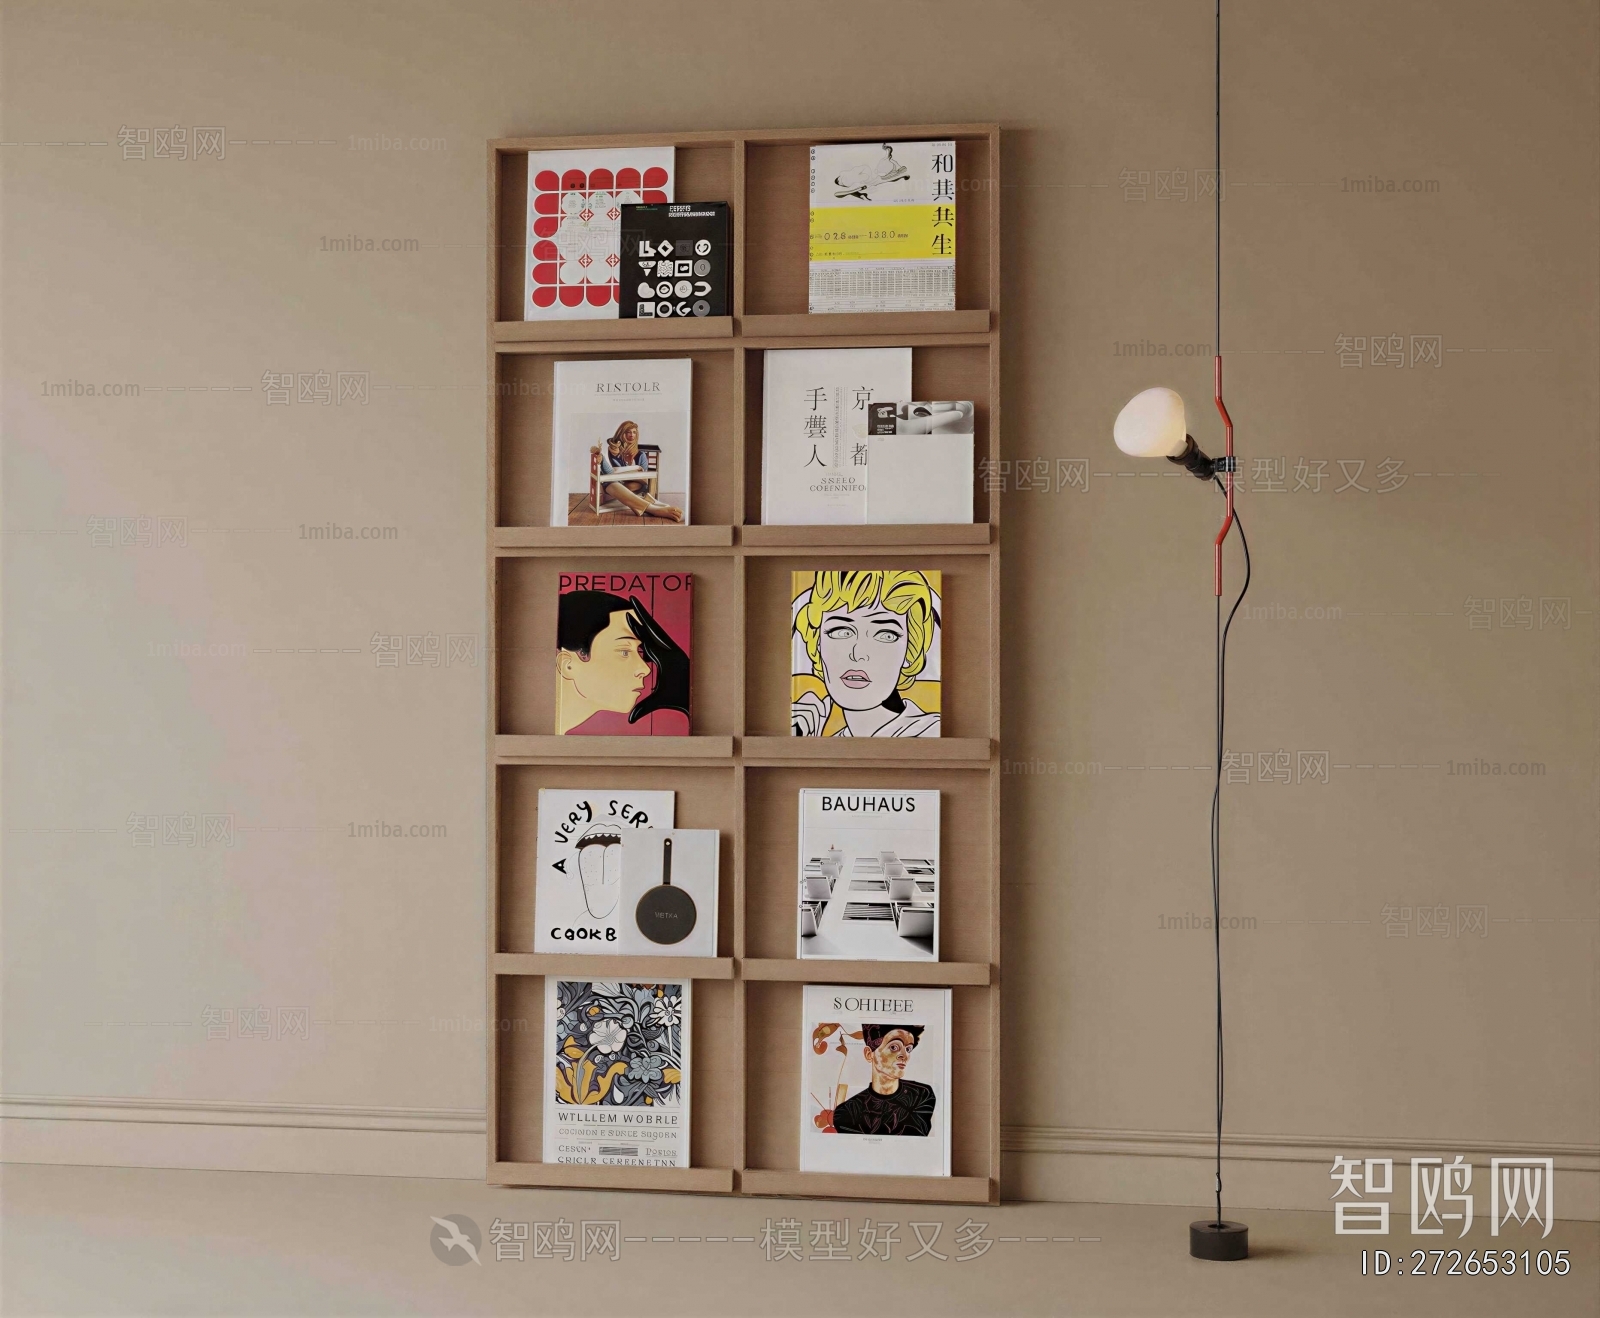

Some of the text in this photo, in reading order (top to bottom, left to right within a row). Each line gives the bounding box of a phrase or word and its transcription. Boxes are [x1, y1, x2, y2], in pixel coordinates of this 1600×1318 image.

[822, 796, 916, 813] BAUHAUS
[554, 801, 593, 844] VERY
[552, 858, 567, 874] A
